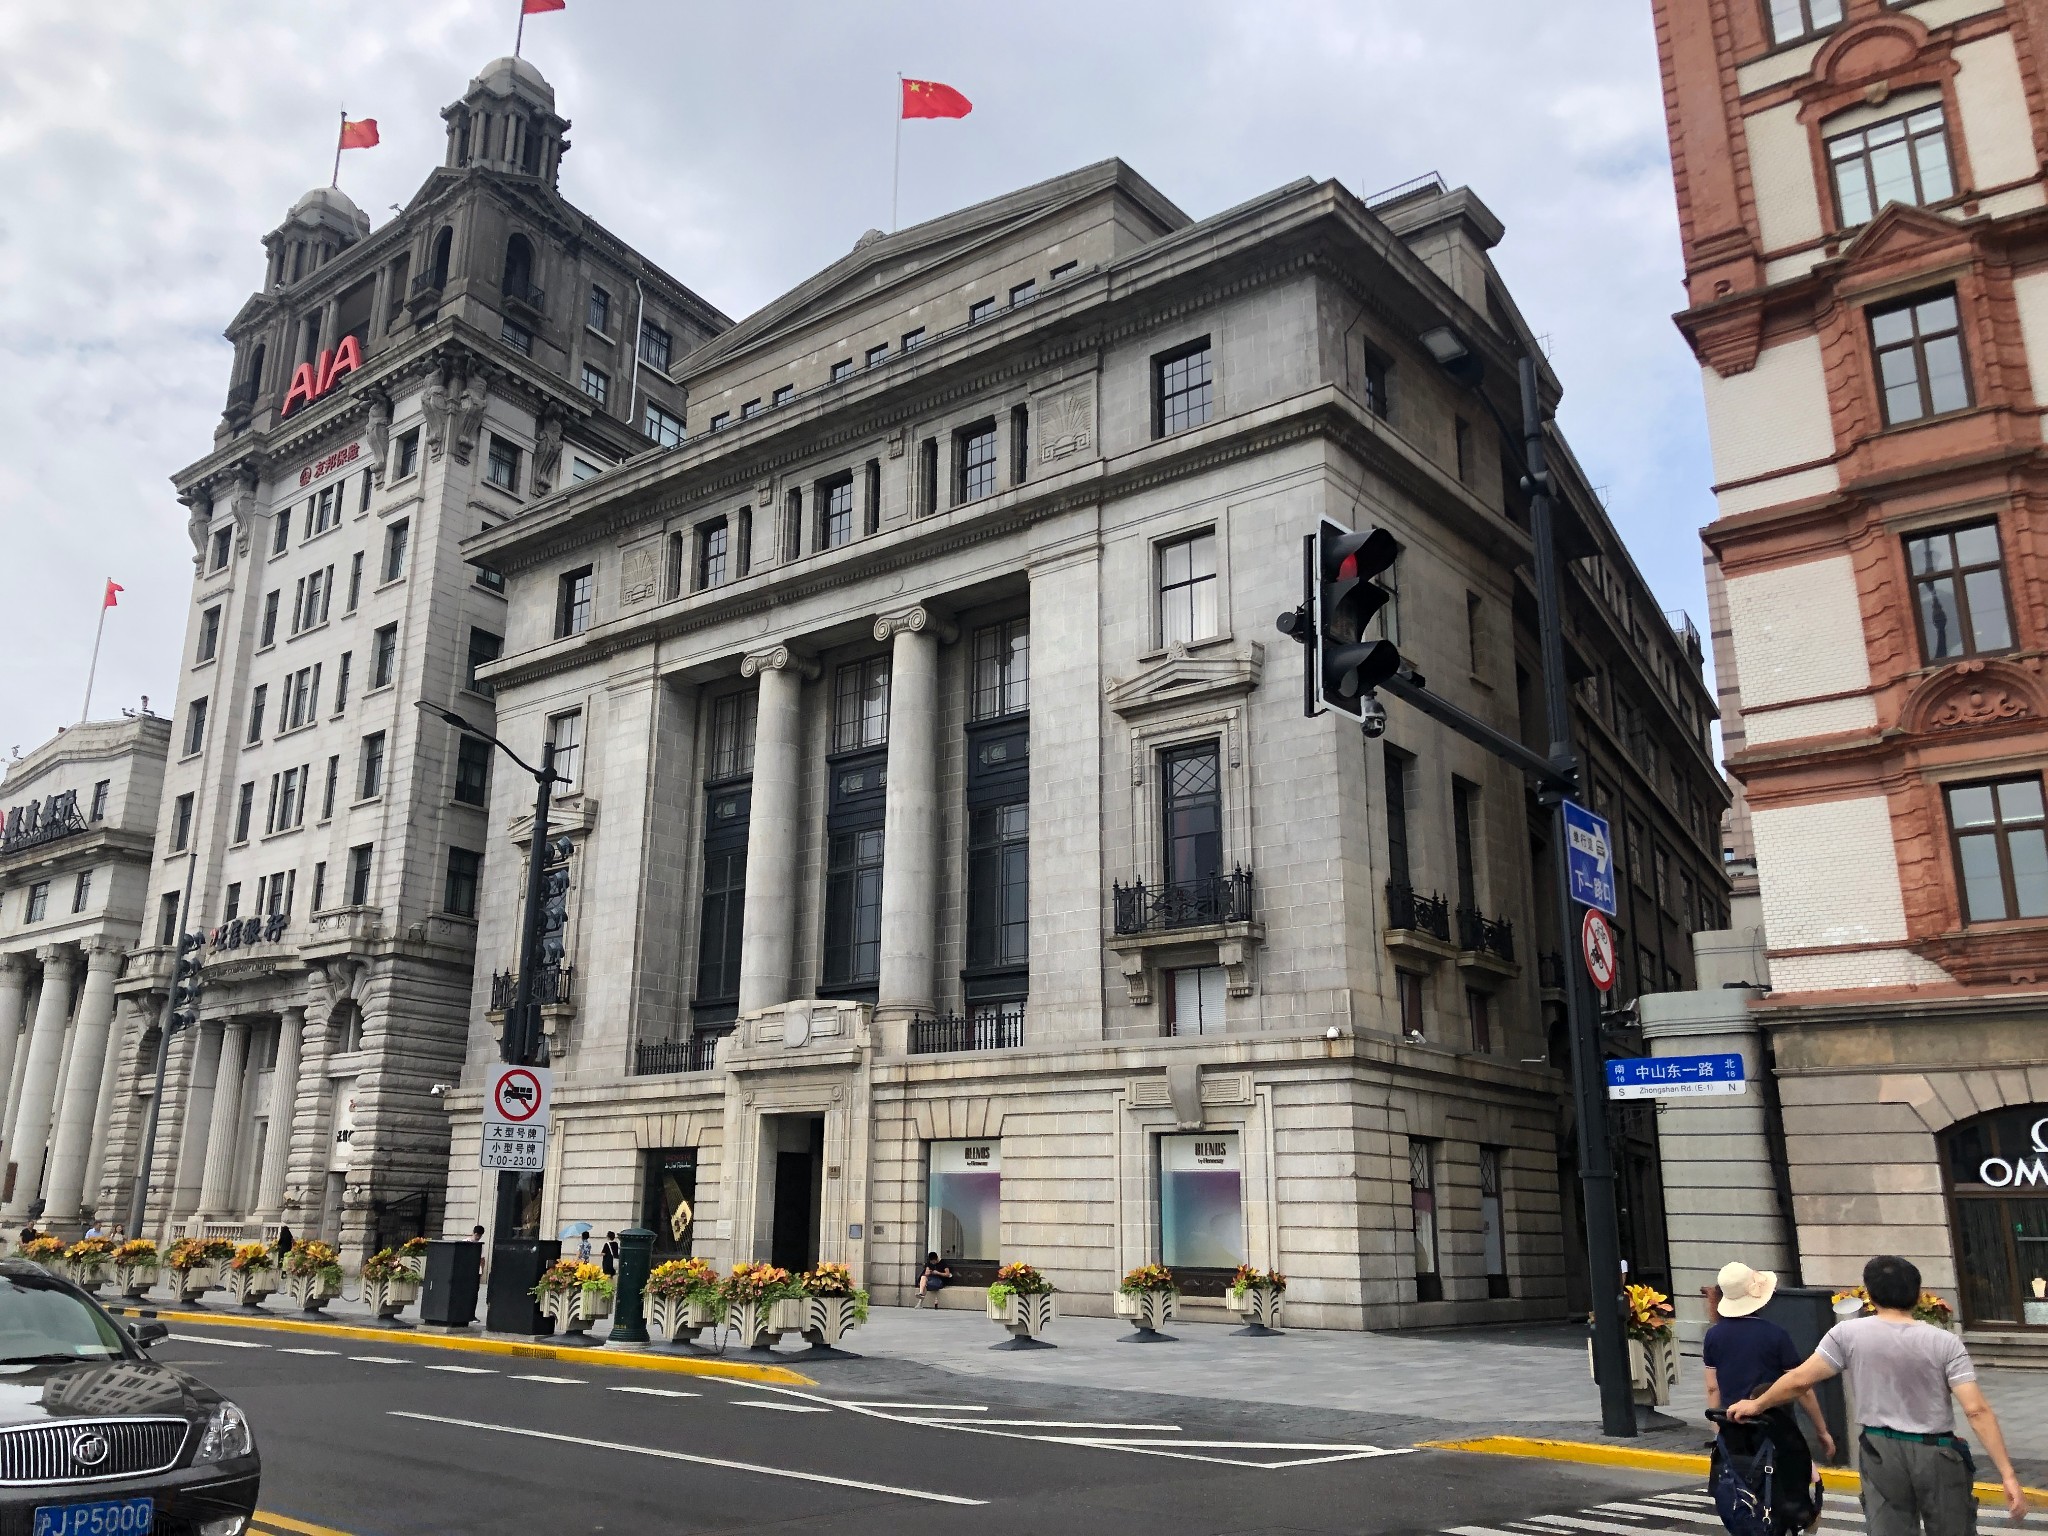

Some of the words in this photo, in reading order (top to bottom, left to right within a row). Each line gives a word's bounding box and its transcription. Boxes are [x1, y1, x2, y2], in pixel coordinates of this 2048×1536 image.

[281, 335, 361, 417] AIA
[314, 443, 360, 479] 友邦保险
[1573, 831, 1594, 852] 单行道
[1575, 869, 1611, 903] 下一路口
[1614, 1065, 1625, 1075] 南
[1724, 1058, 1736, 1069] 北
[1635, 1062, 1714, 1080] 中山东一路
[1726, 1070, 1736, 1078] 18
[1618, 1088, 1625, 1096] S
[1640, 1085, 1679, 1095] Zhongshan
[1728, 1083, 1736, 1092] N
[493, 1126, 537, 1139] 大型号牌
[491, 1142, 536, 1155] 小型号牌
[964, 1146, 991, 1160] BLENDS
[1194, 1142, 1227, 1156] BLENDS
[488, 1155, 537, 1167] 7:00-23:00
